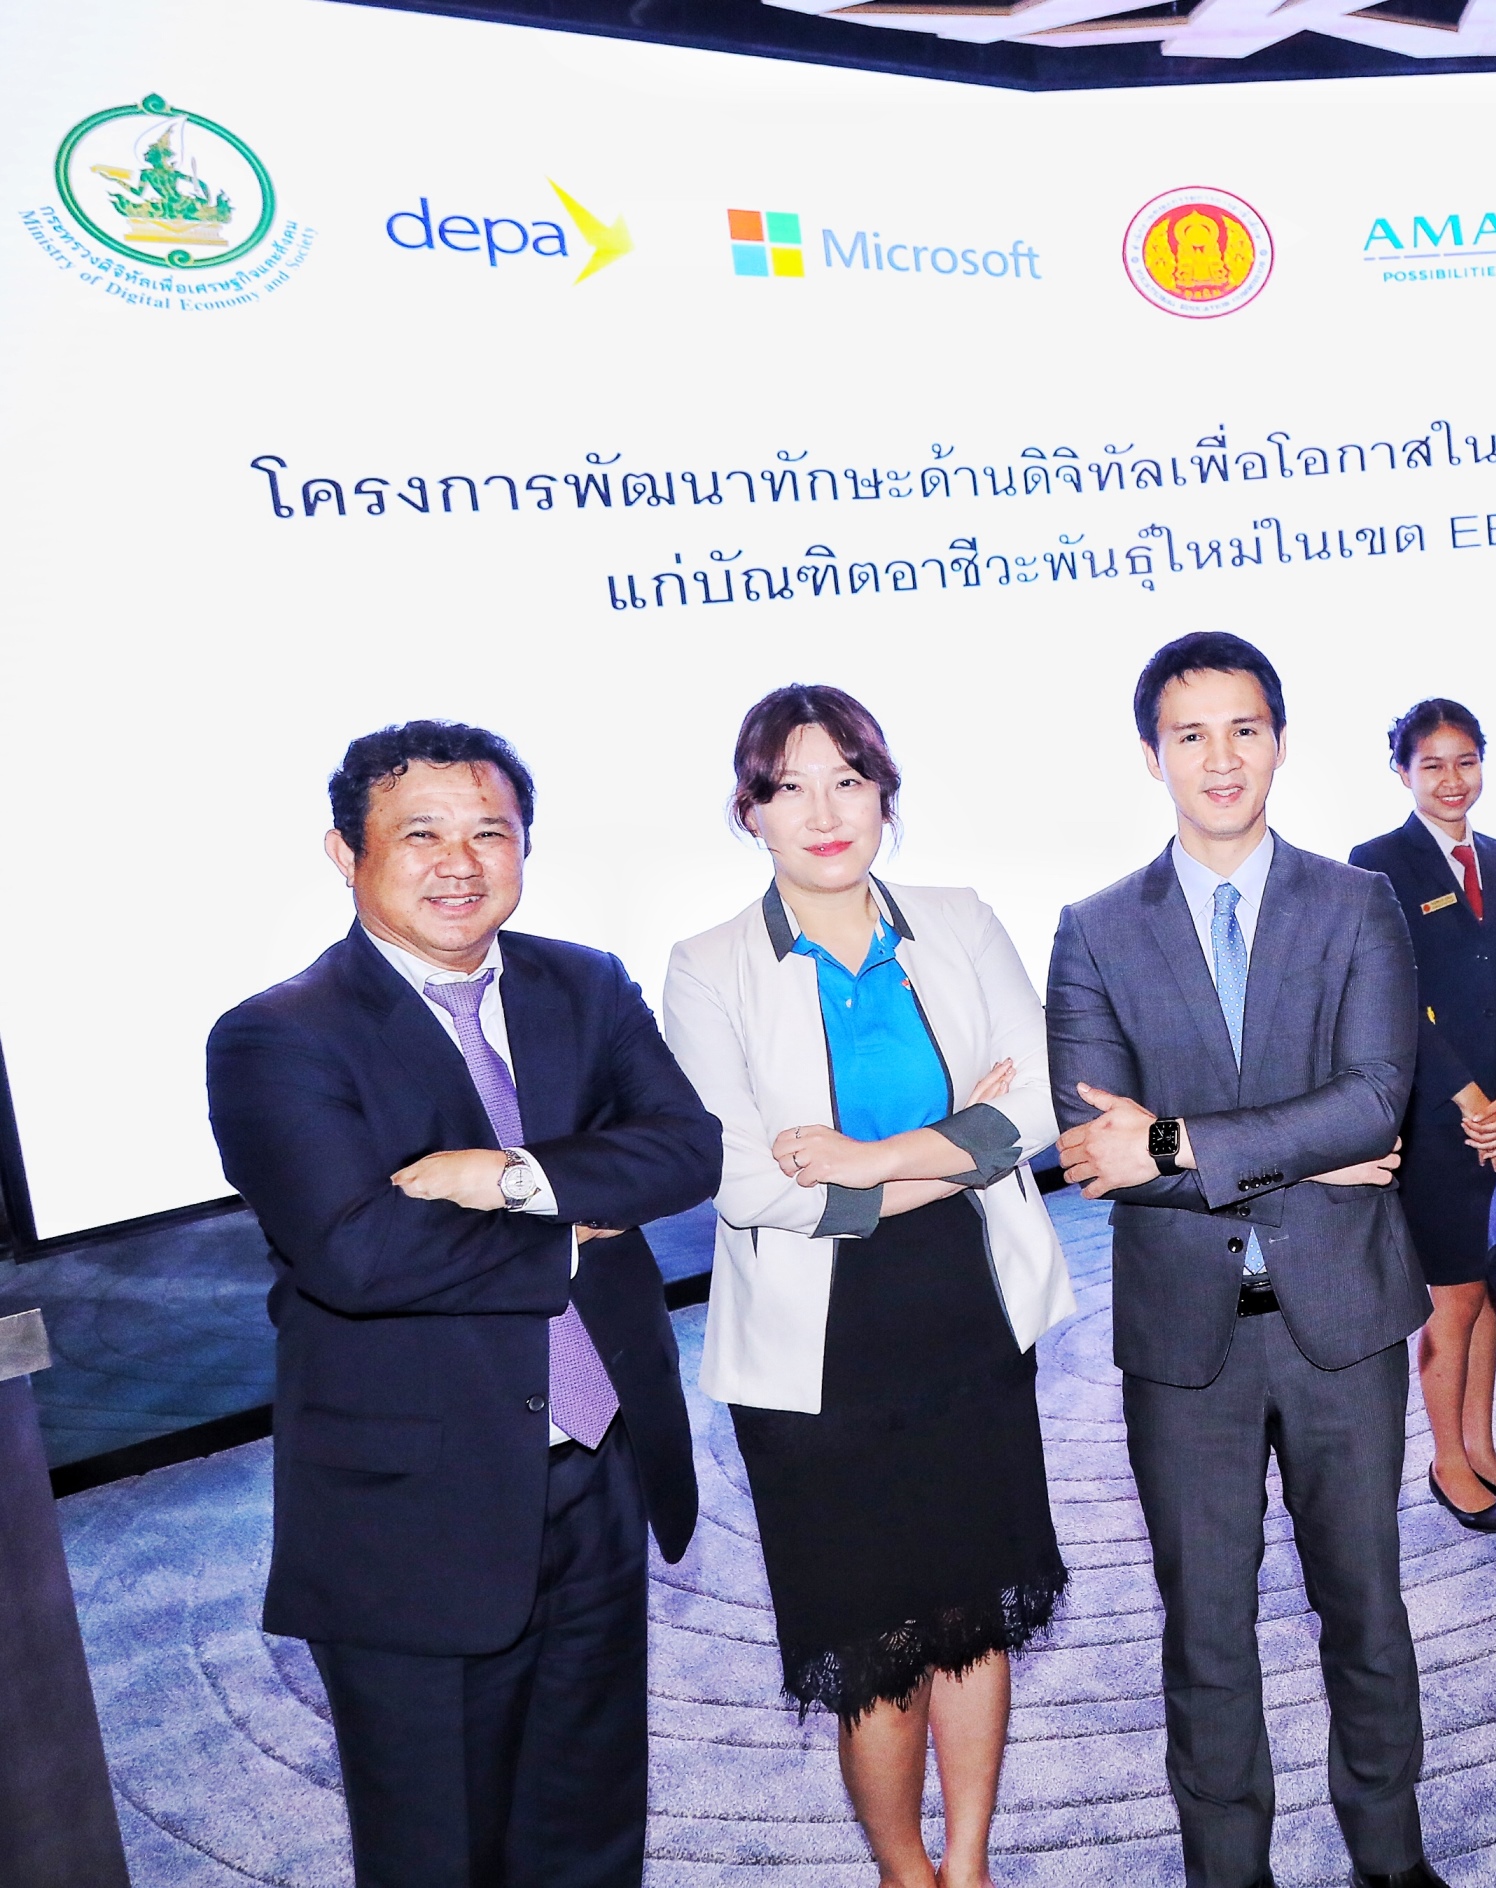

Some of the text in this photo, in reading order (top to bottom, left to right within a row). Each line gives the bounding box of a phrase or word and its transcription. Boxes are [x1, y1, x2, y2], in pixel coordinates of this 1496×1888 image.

[17, 208, 320, 311] Ministry of Digital Economy and Society
[385, 197, 569, 267] depa
[821, 228, 1042, 280] Microsoft
[607, 517, 1426, 611] แก่บัณฑิตอาชีวะพันธุ์ใหม่ในเขต
